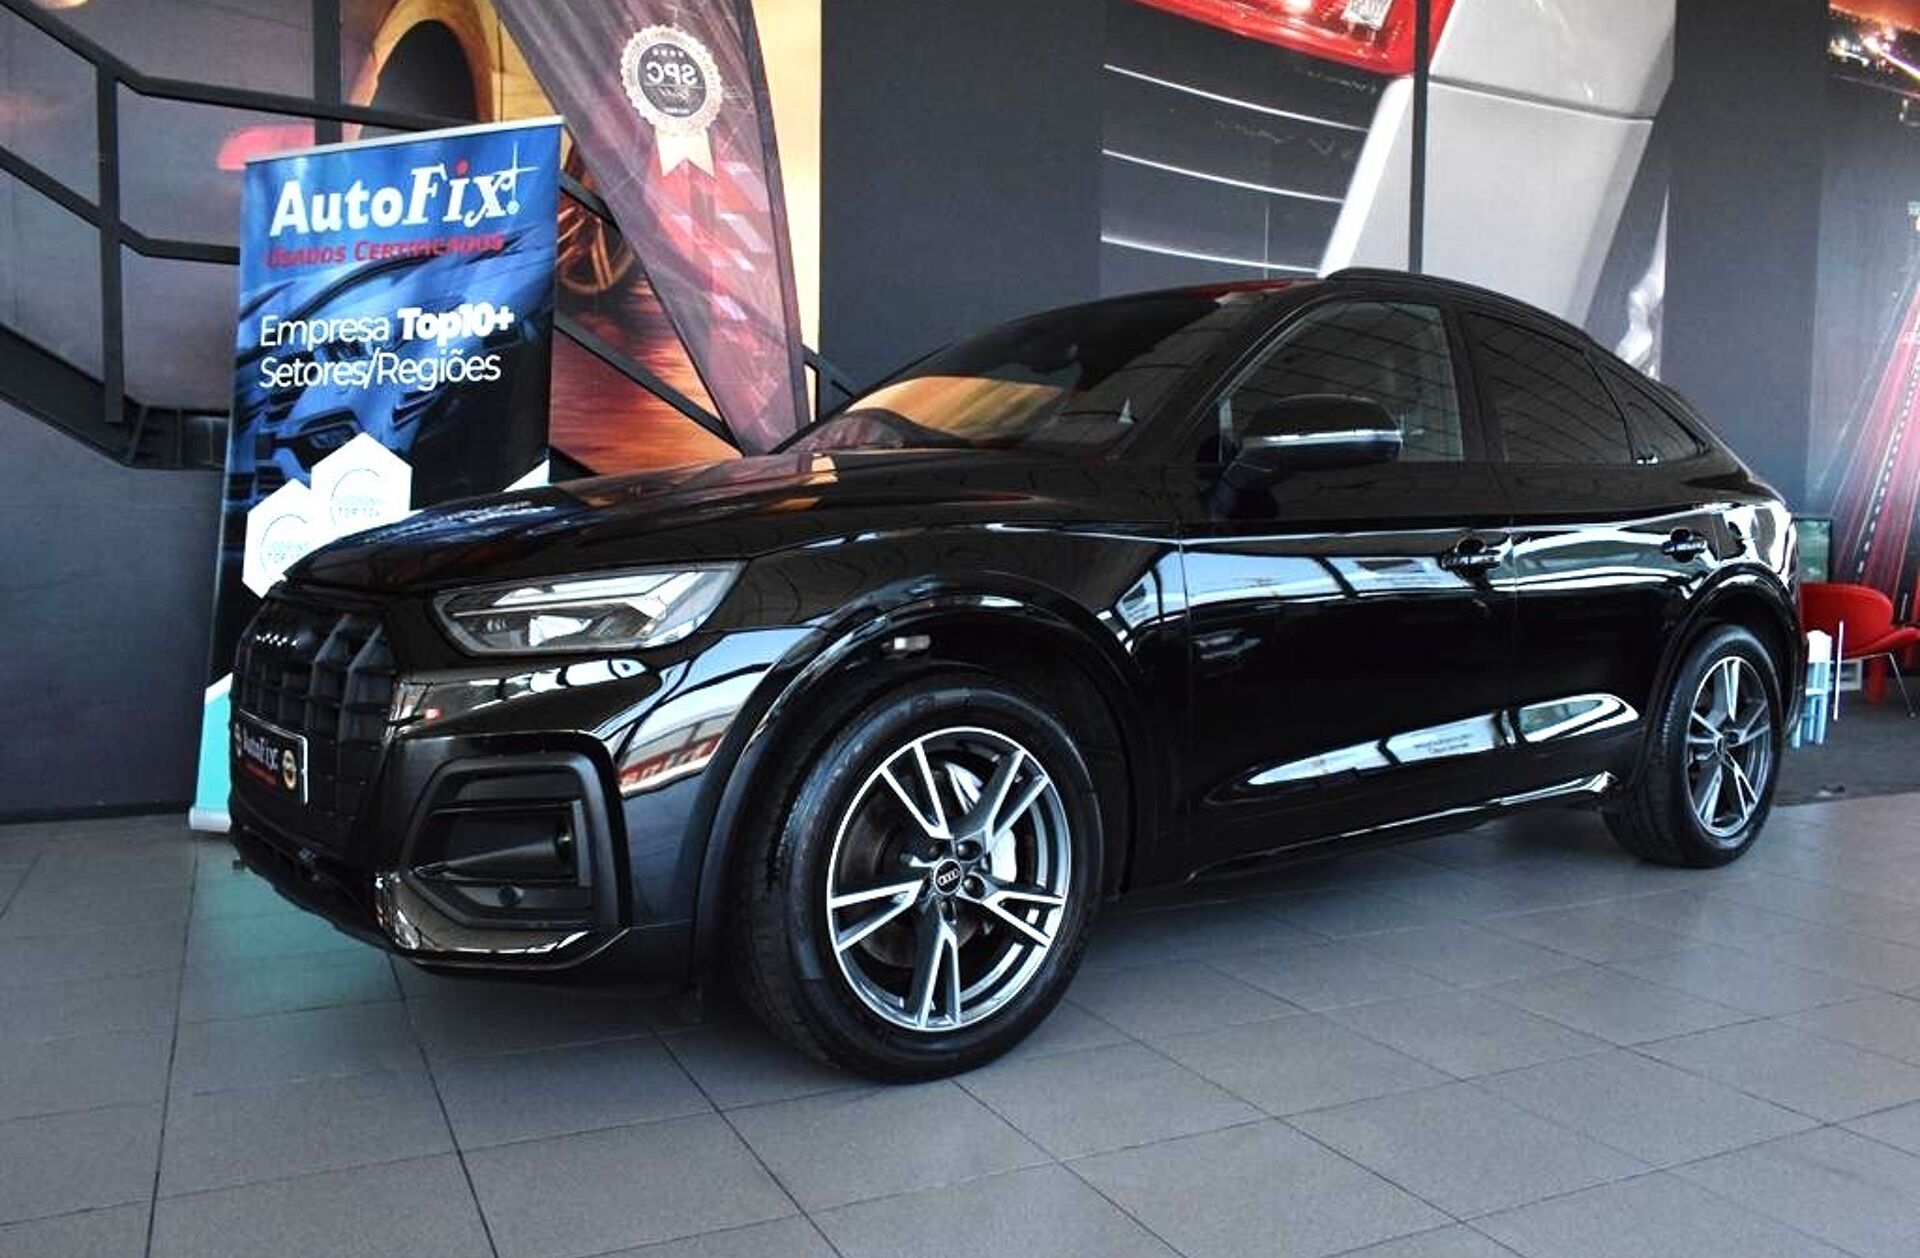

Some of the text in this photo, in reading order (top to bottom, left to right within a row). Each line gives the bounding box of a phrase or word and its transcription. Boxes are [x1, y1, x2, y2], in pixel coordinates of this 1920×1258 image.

[259, 301, 515, 351] Empresa Top10+
[259, 346, 502, 390] Setores/Regiões
